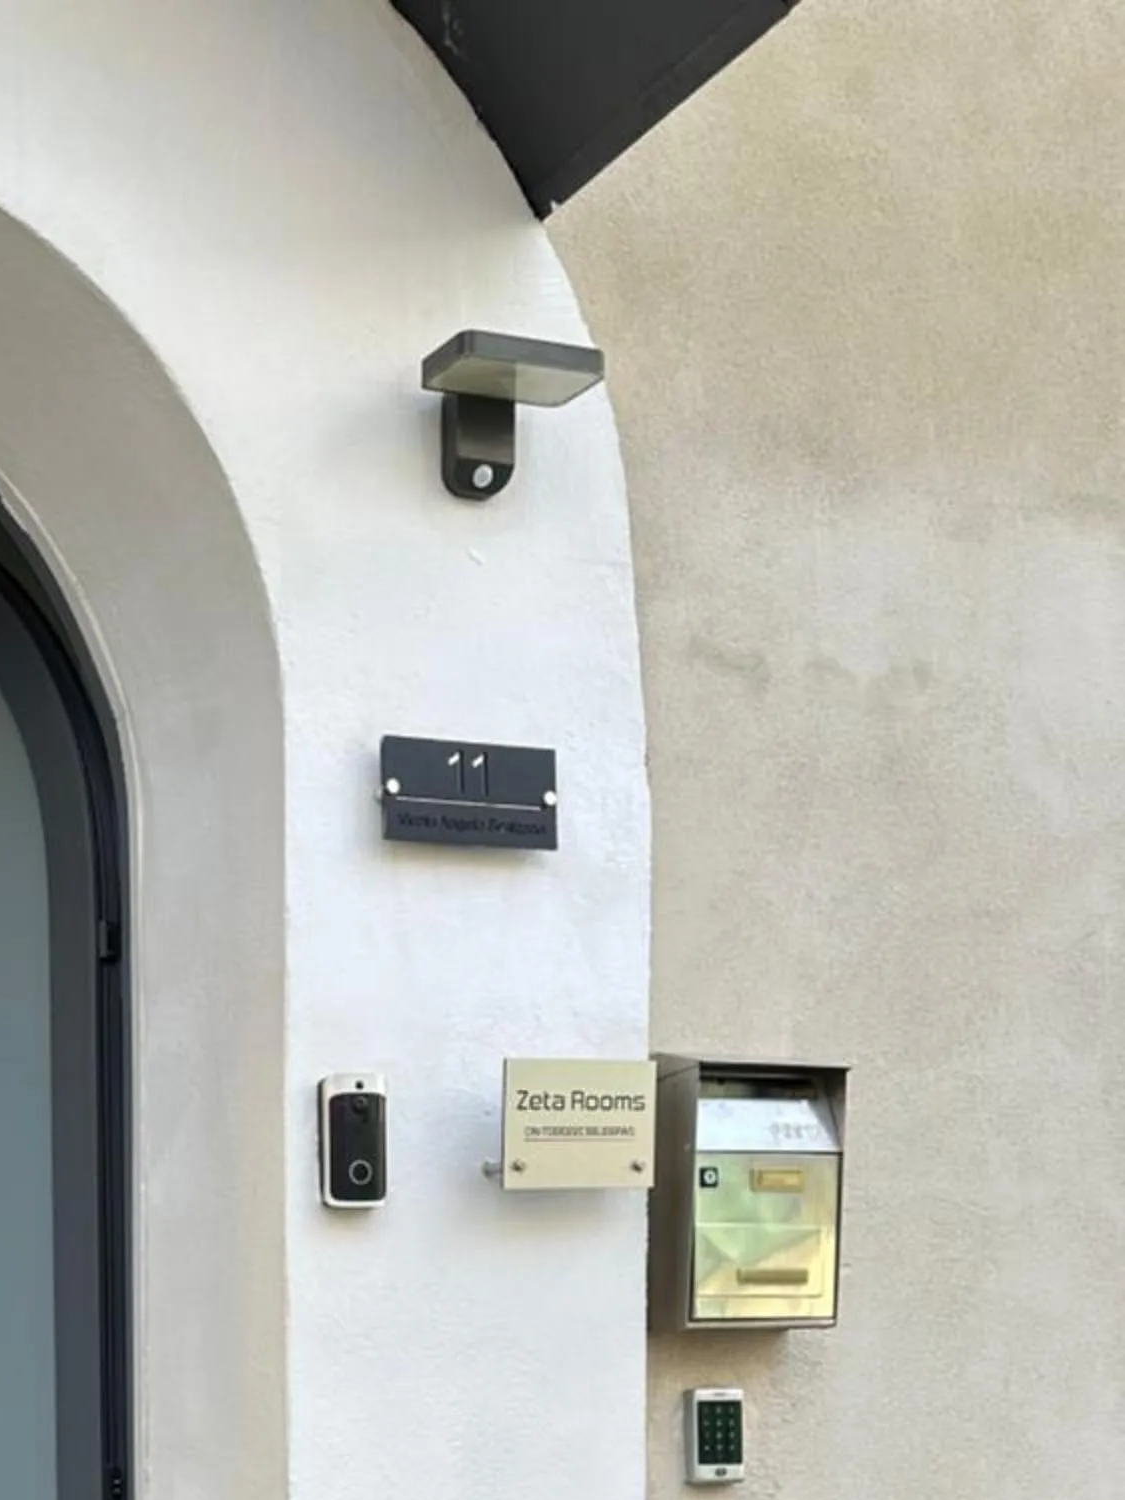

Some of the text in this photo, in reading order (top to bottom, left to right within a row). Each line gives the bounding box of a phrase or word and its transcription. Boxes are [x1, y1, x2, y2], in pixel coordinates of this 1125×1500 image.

[447, 749, 490, 797] 11
[515, 1089, 646, 1112] Zeta Rooms
